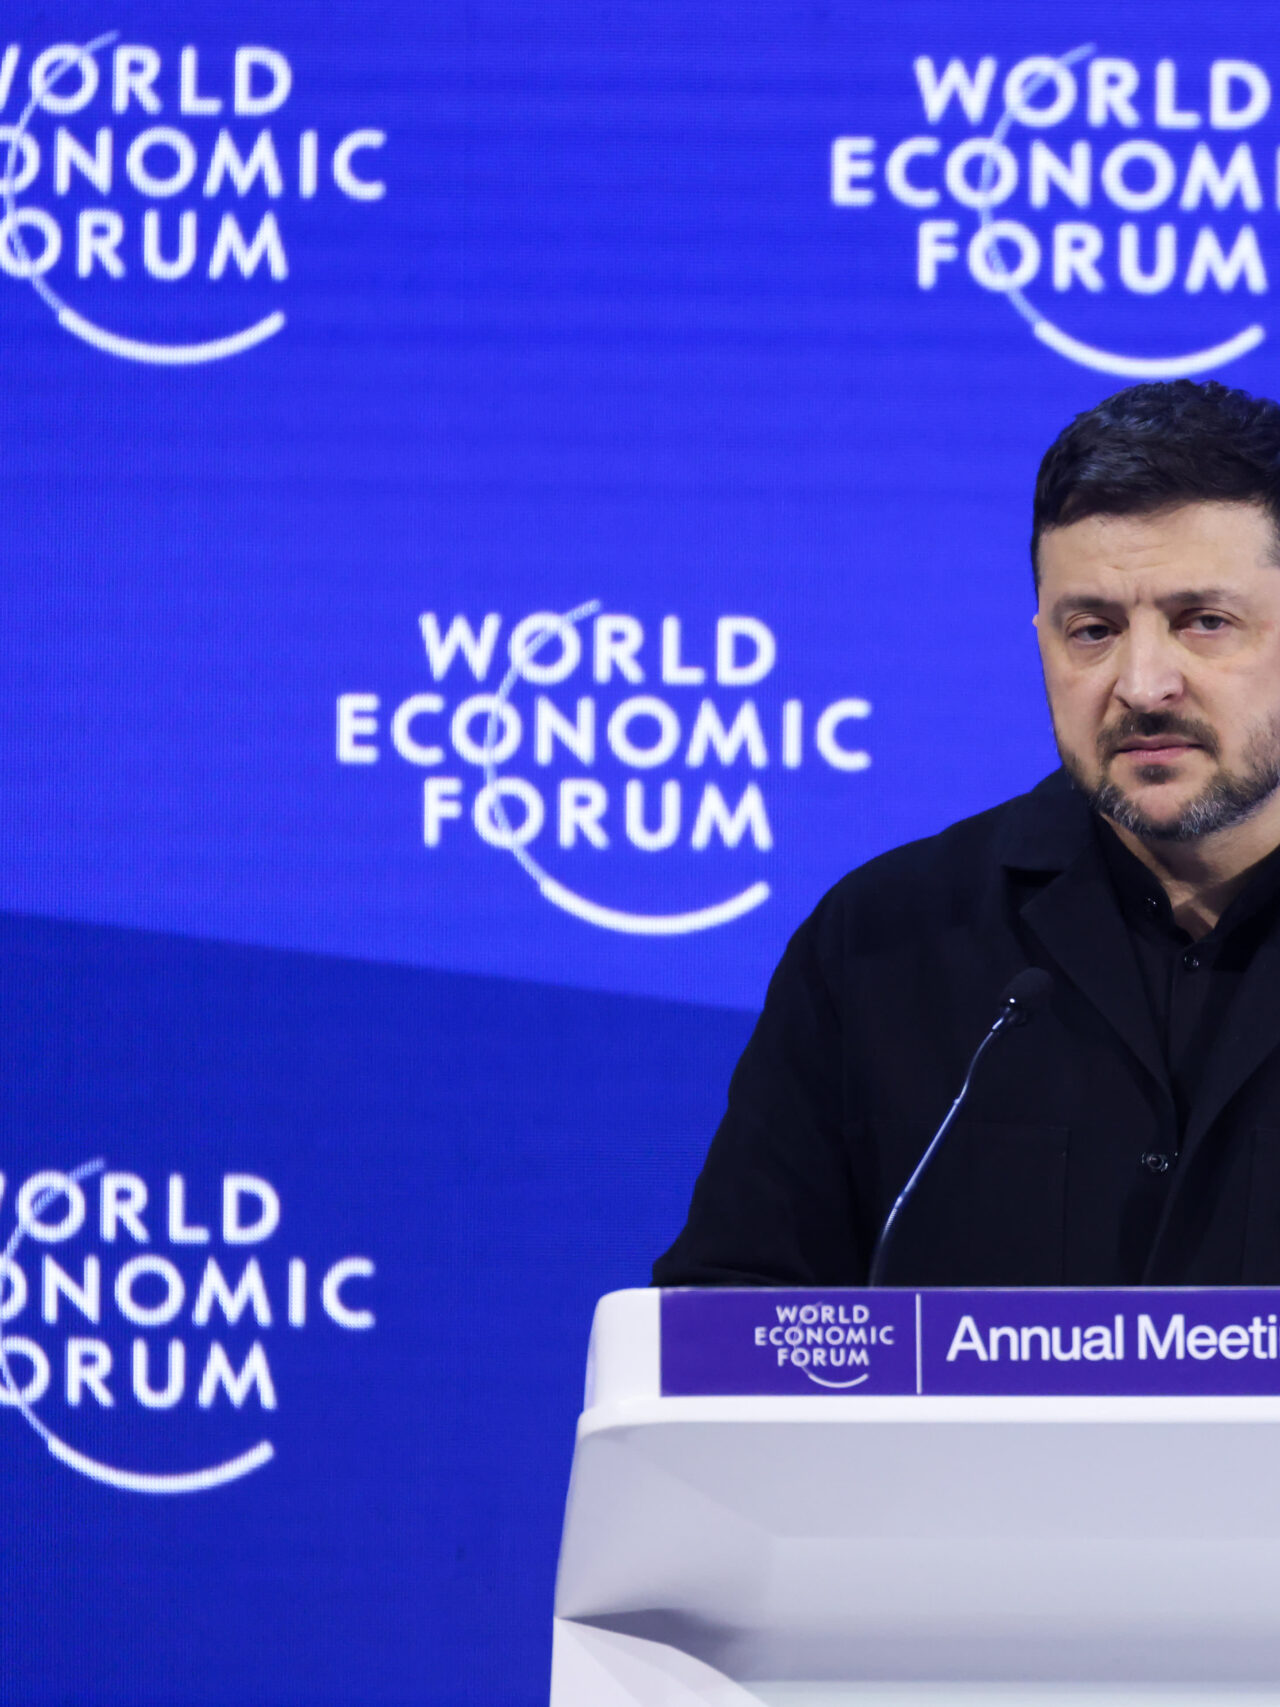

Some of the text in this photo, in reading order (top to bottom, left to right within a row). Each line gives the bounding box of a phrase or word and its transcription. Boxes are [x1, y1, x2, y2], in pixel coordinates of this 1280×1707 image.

[0, 43, 292, 116] ORLD
[914, 55, 1271, 130] WORLD
[0, 125, 386, 201] ONOMIC
[0, 206, 289, 281] ORUM
[917, 219, 1268, 294] FORUM
[418, 611, 777, 687] WORLD
[335, 692, 872, 772] ECONOMIC
[423, 776, 773, 852] FORUM
[0, 1171, 280, 1244] ORLD
[754, 1325, 895, 1346] ECONOMIC
[775, 1304, 870, 1325] WORLD
[946, 1315, 1125, 1362] Annual
[0, 1334, 278, 1410] ORUM
[777, 1347, 870, 1368] FORUM
